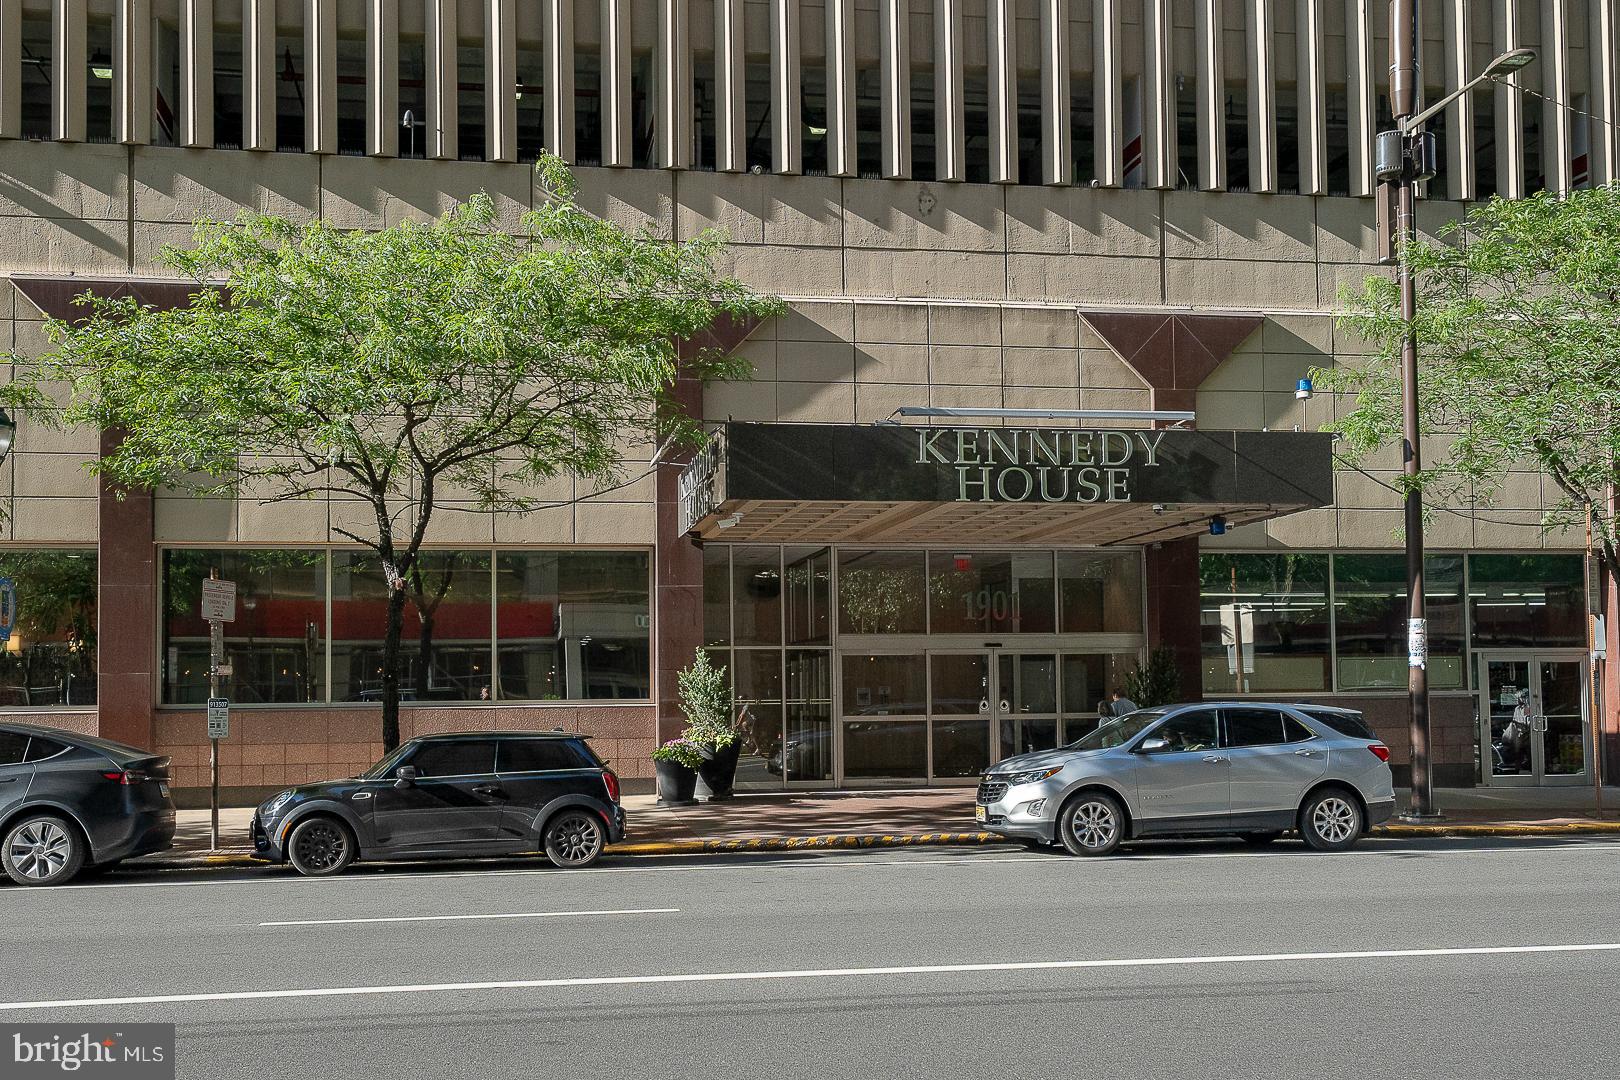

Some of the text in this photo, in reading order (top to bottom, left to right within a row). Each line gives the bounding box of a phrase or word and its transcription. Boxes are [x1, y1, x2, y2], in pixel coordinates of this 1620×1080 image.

[915, 429, 1166, 466] KENNEDY
[955, 466, 1131, 503] HOUSE
[962, 590, 1022, 620] 1901
